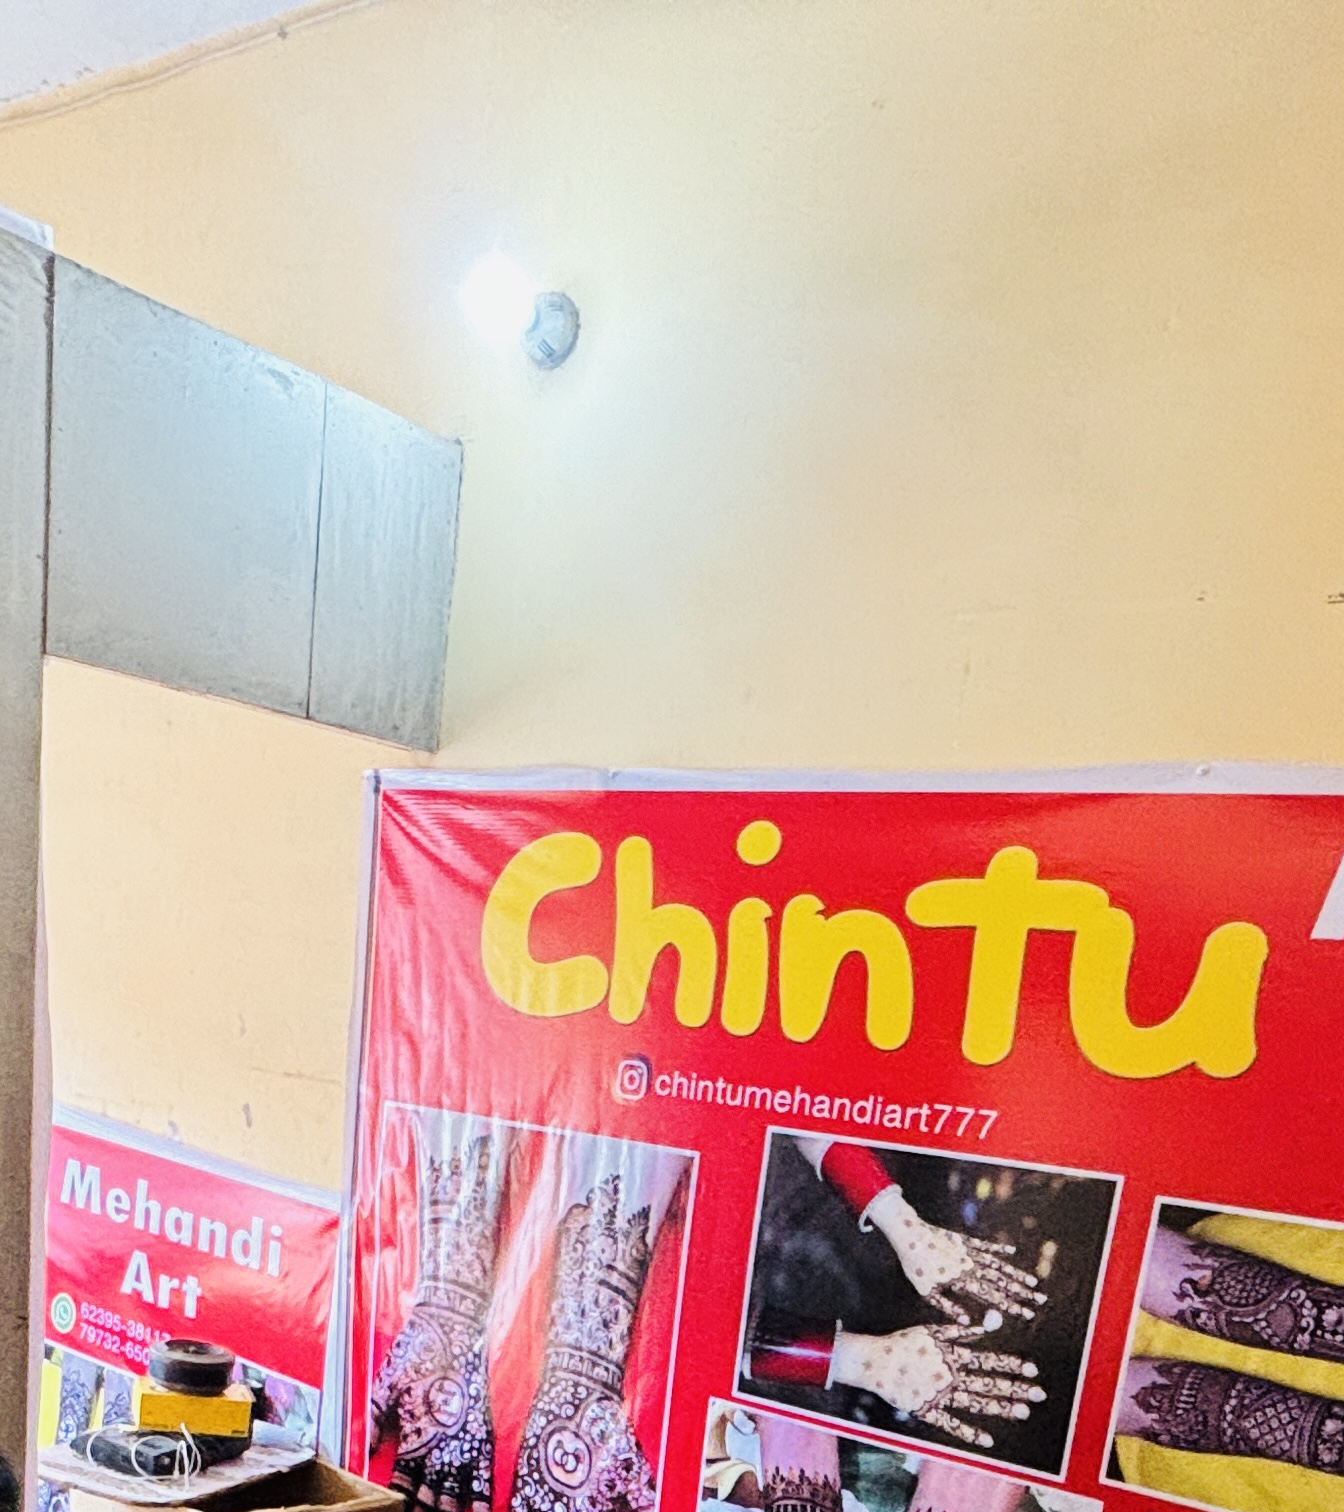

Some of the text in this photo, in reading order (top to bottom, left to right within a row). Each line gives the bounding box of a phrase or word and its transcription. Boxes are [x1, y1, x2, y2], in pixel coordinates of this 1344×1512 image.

[481, 820, 1269, 1079] Chintu
[656, 1069, 999, 1141] chintumehandiart777
[59, 1158, 284, 1278] Mehandi
[120, 1250, 202, 1319] Art
[79, 1321, 151, 1367] 79732-650
